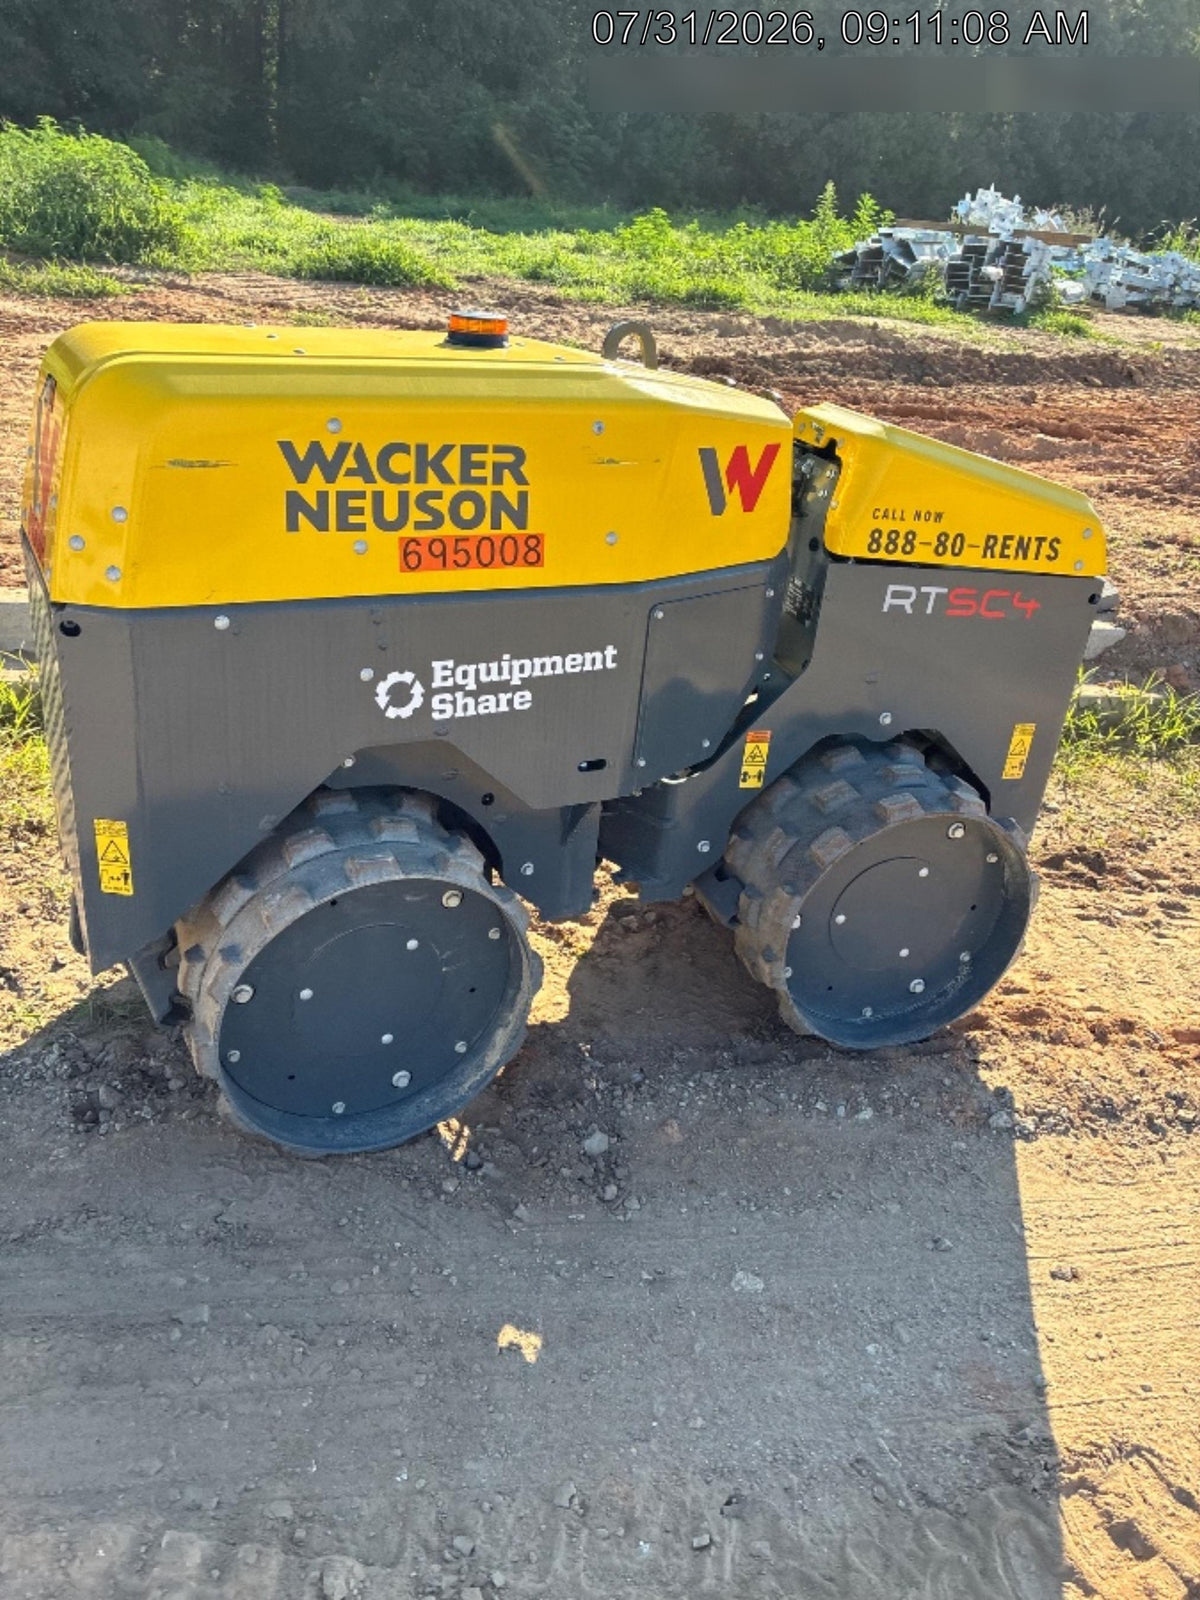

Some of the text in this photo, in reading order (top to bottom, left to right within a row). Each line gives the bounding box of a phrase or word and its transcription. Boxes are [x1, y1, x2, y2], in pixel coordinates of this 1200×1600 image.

[277, 440, 530, 485] WACKER
[286, 489, 529, 532] NEUSON
[872, 508, 945, 523] CALL NOW
[402, 534, 541, 570] 695008
[867, 528, 1062, 562] 888-80-RENTS
[882, 584, 1040, 618] RTSC4
[431, 645, 617, 690] Equipment
[431, 689, 533, 721] Share
